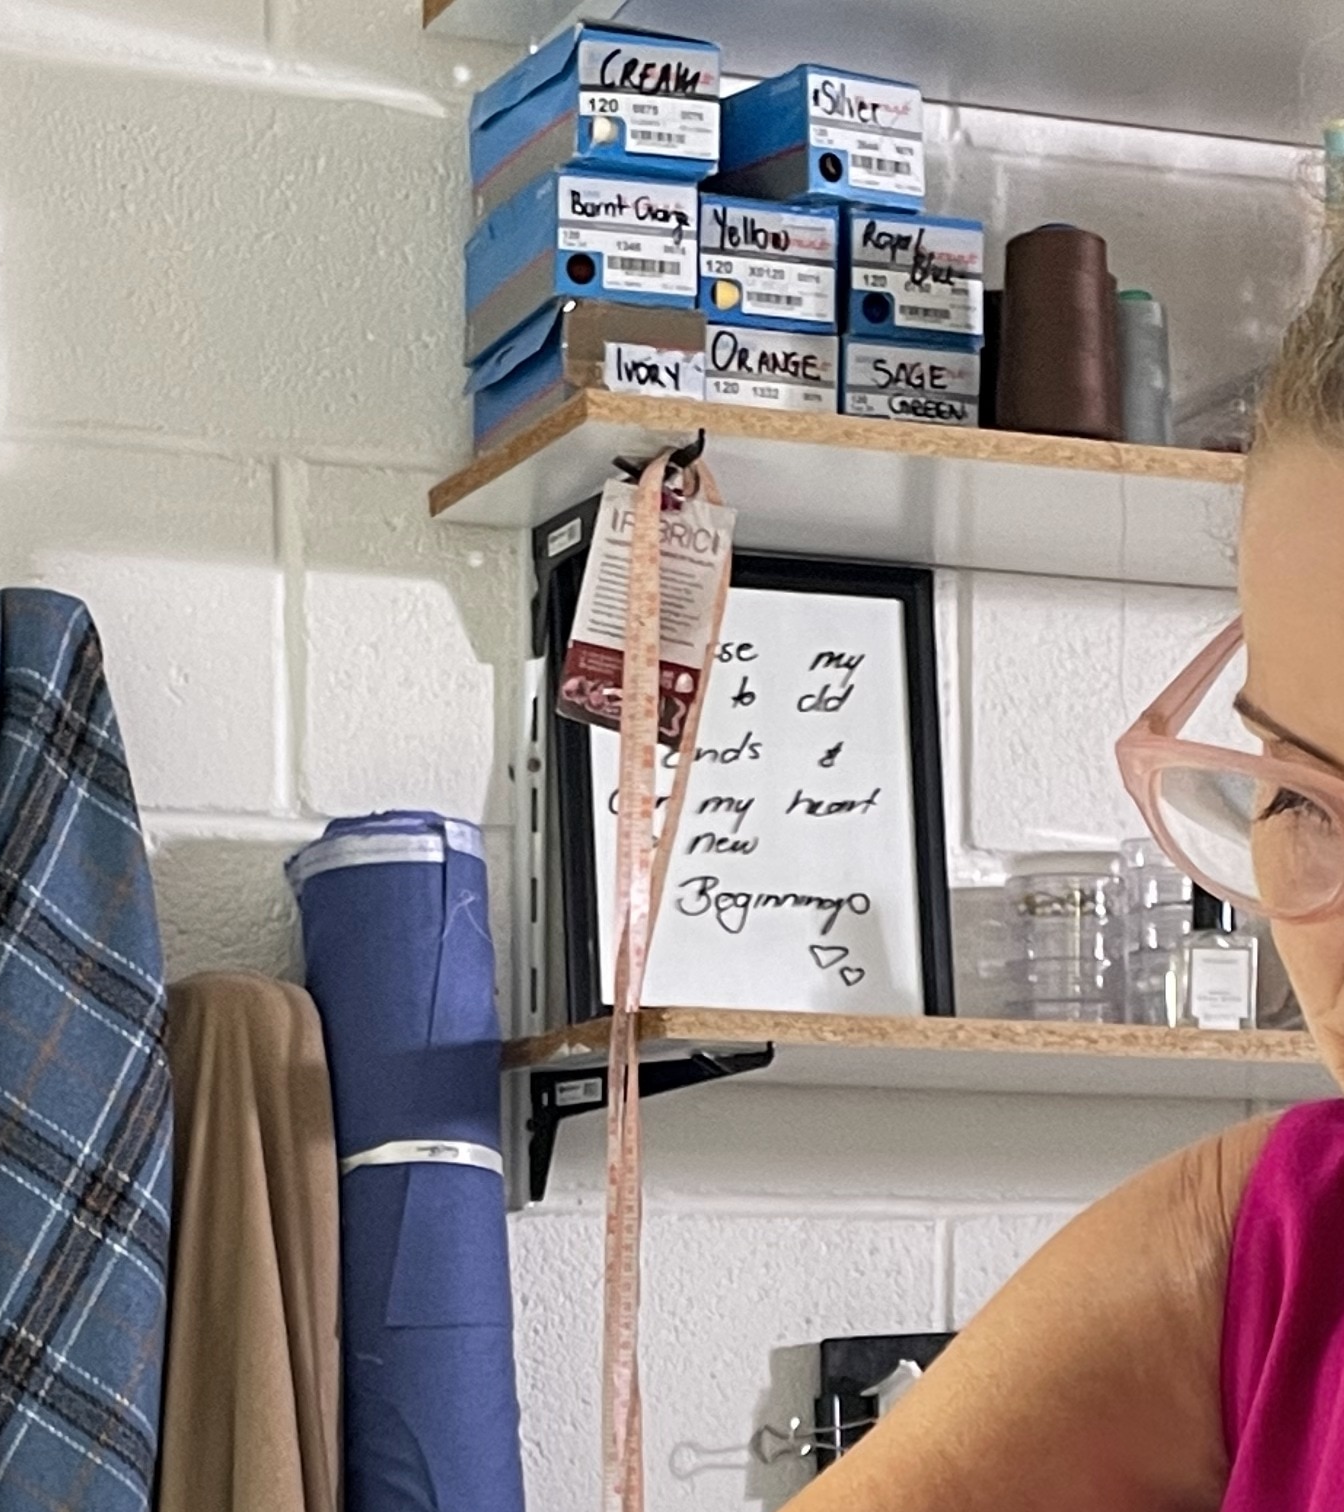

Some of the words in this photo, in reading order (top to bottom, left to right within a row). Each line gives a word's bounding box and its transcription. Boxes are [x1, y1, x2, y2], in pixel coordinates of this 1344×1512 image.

[600, 48, 701, 95] CREAM
[588, 97, 619, 114] 120
[713, 206, 791, 252] Yellow
[705, 259, 734, 275] 120
[616, 347, 681, 392] IVORY
[711, 330, 822, 382] ORANGE
[870, 358, 948, 390] SAGE
[713, 380, 740, 395] 120
[808, 651, 866, 688] my
[696, 795, 756, 833] my
[785, 787, 882, 817] heart
[685, 832, 759, 856] new
